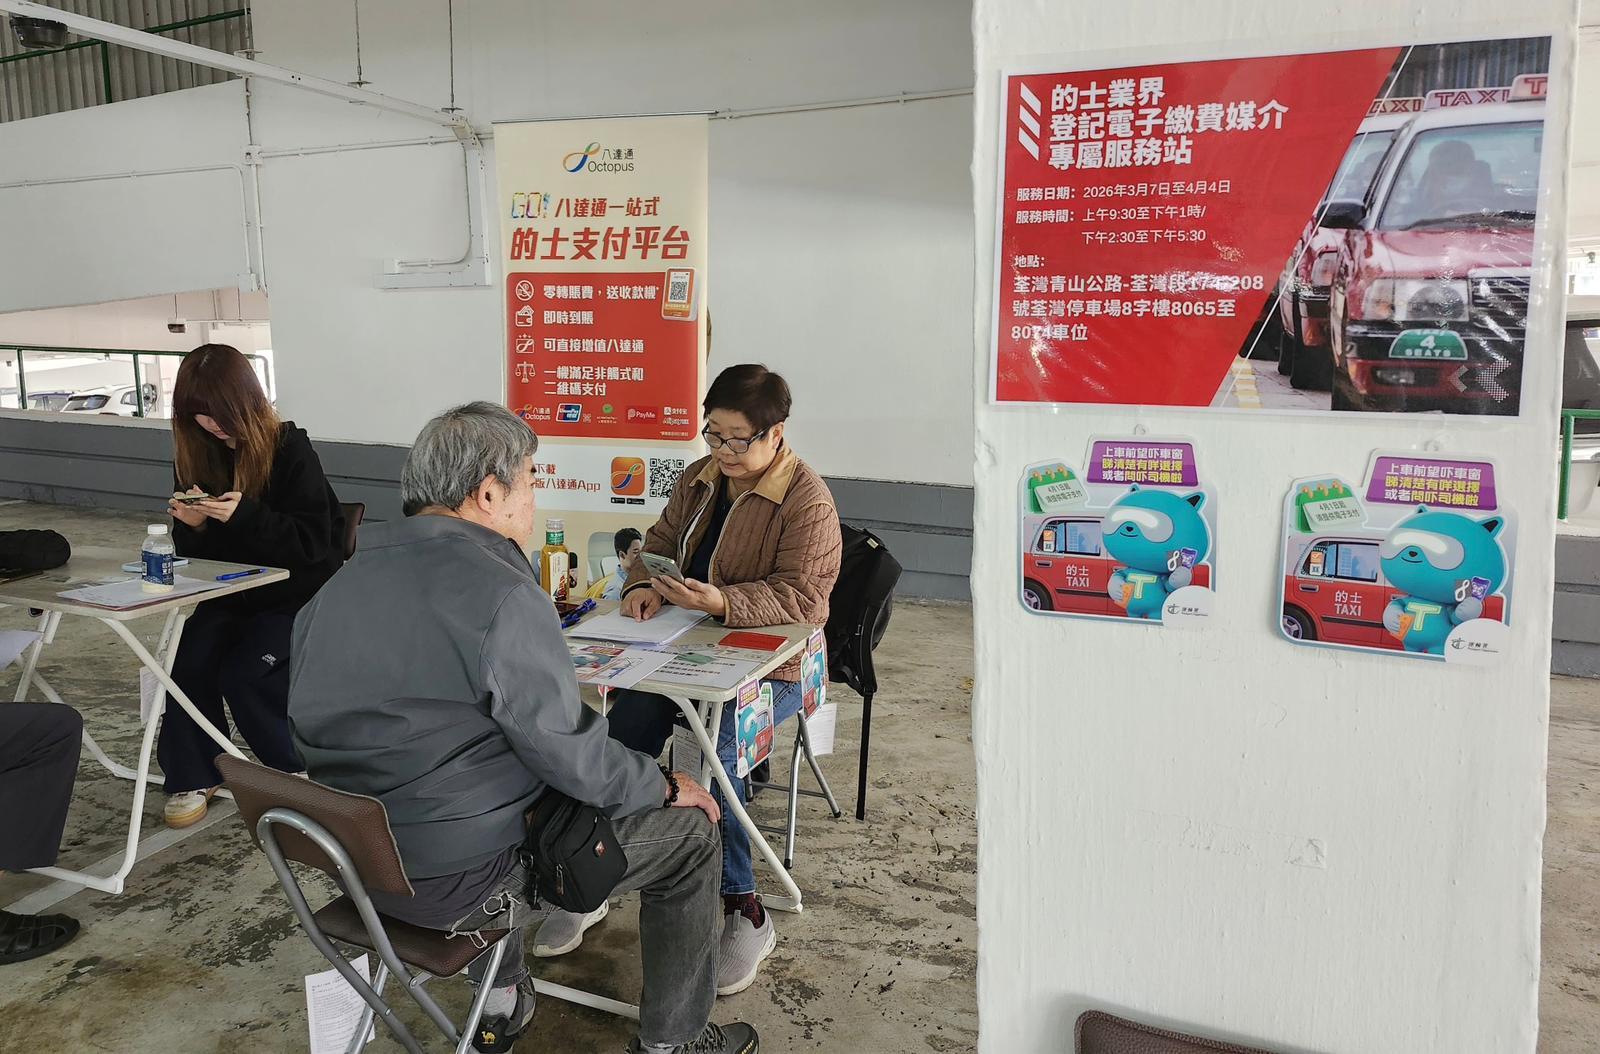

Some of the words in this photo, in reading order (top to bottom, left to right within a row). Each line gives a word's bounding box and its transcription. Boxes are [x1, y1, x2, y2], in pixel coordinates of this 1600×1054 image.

[1051, 76, 1166, 112] 的士業界
[1435, 90, 1510, 107] TAXI
[1049, 99, 1289, 142] 登記電子繳費媒介
[601, 149, 634, 160] 八達通
[1048, 137, 1193, 171] 專屬服務站
[588, 161, 635, 175] Octopus
[555, 197, 660, 219] 八達通一站式
[510, 225, 690, 260] 的士支付平台
[1082, 228, 1206, 245] 下午2:30至下午5:30
[1011, 299, 1236, 319] 號荃灣停車場8字樓8065至
[543, 338, 644, 353] 可直接增值八達通
[1420, 335, 1436, 349] 4
[543, 366, 644, 381] 一機滿足非觸式和
[543, 381, 607, 396] 二維碼支付
[636, 411, 656, 419] PayMe
[535, 463, 556, 475] 下載
[1066, 565, 1089, 577] 的士
[1066, 577, 1089, 588] TAXI
[1335, 591, 1362, 604] 的士
[1335, 604, 1362, 616] TAXI
